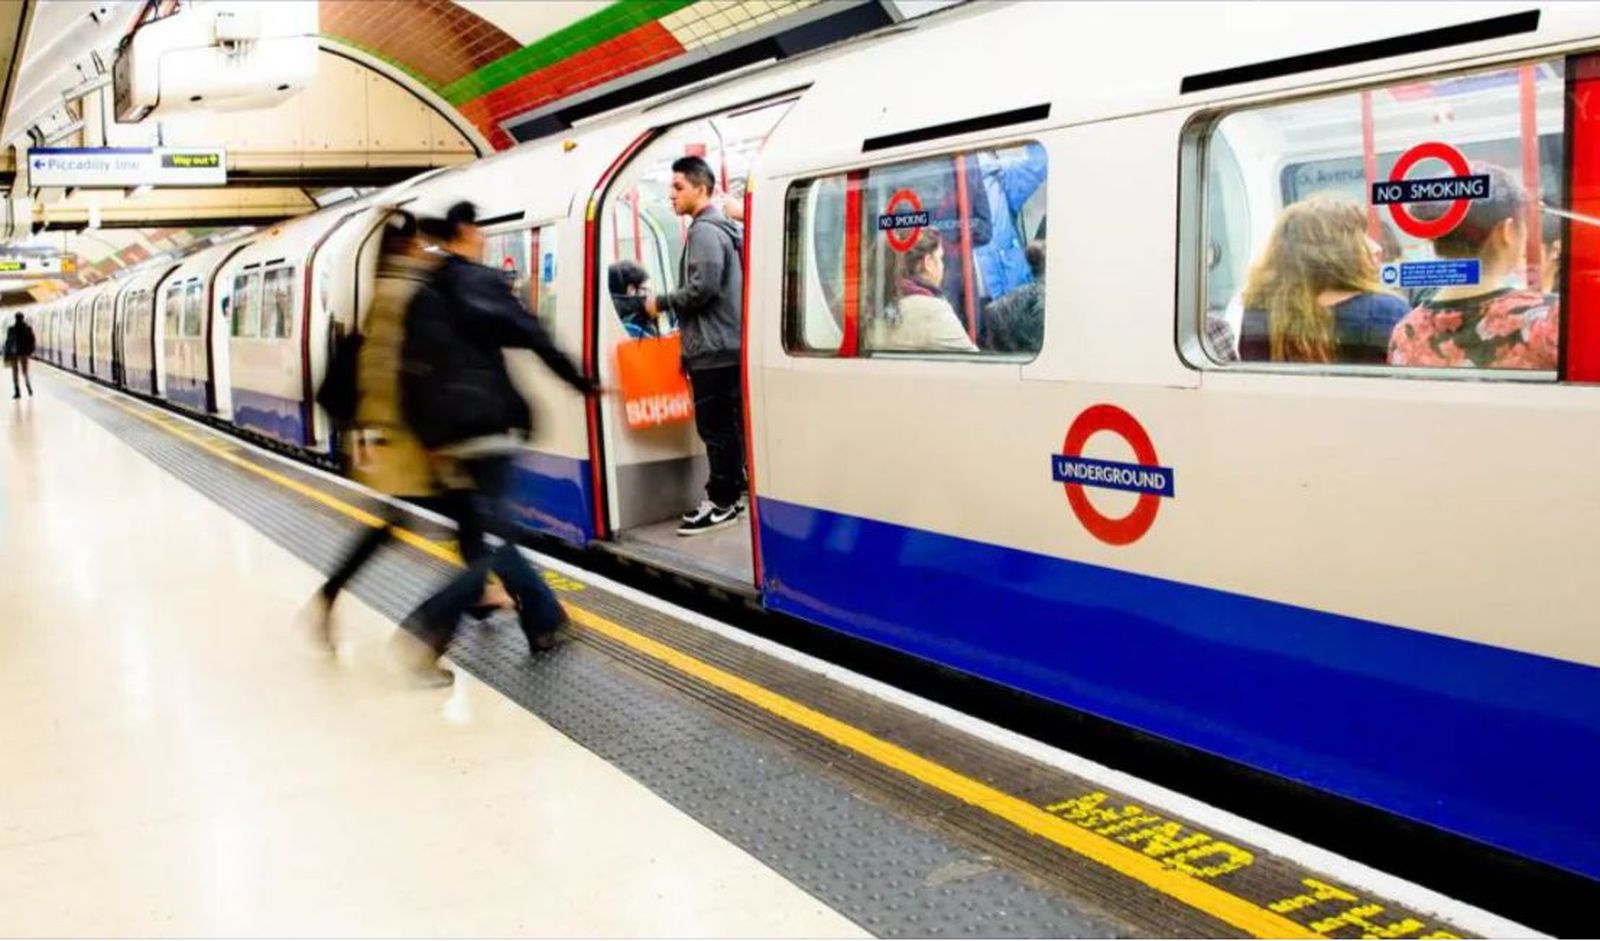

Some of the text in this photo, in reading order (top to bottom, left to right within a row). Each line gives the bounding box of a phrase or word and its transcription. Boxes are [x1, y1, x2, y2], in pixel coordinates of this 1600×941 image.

[48, 159, 111, 171] Piccadilly
[1377, 180, 1484, 201] NO SMOKING
[880, 217, 892, 228] NO
[895, 213, 927, 226] SMOKING
[1058, 461, 1166, 490] UNDERGROUND
[1046, 791, 1460, 939] MIND TH
